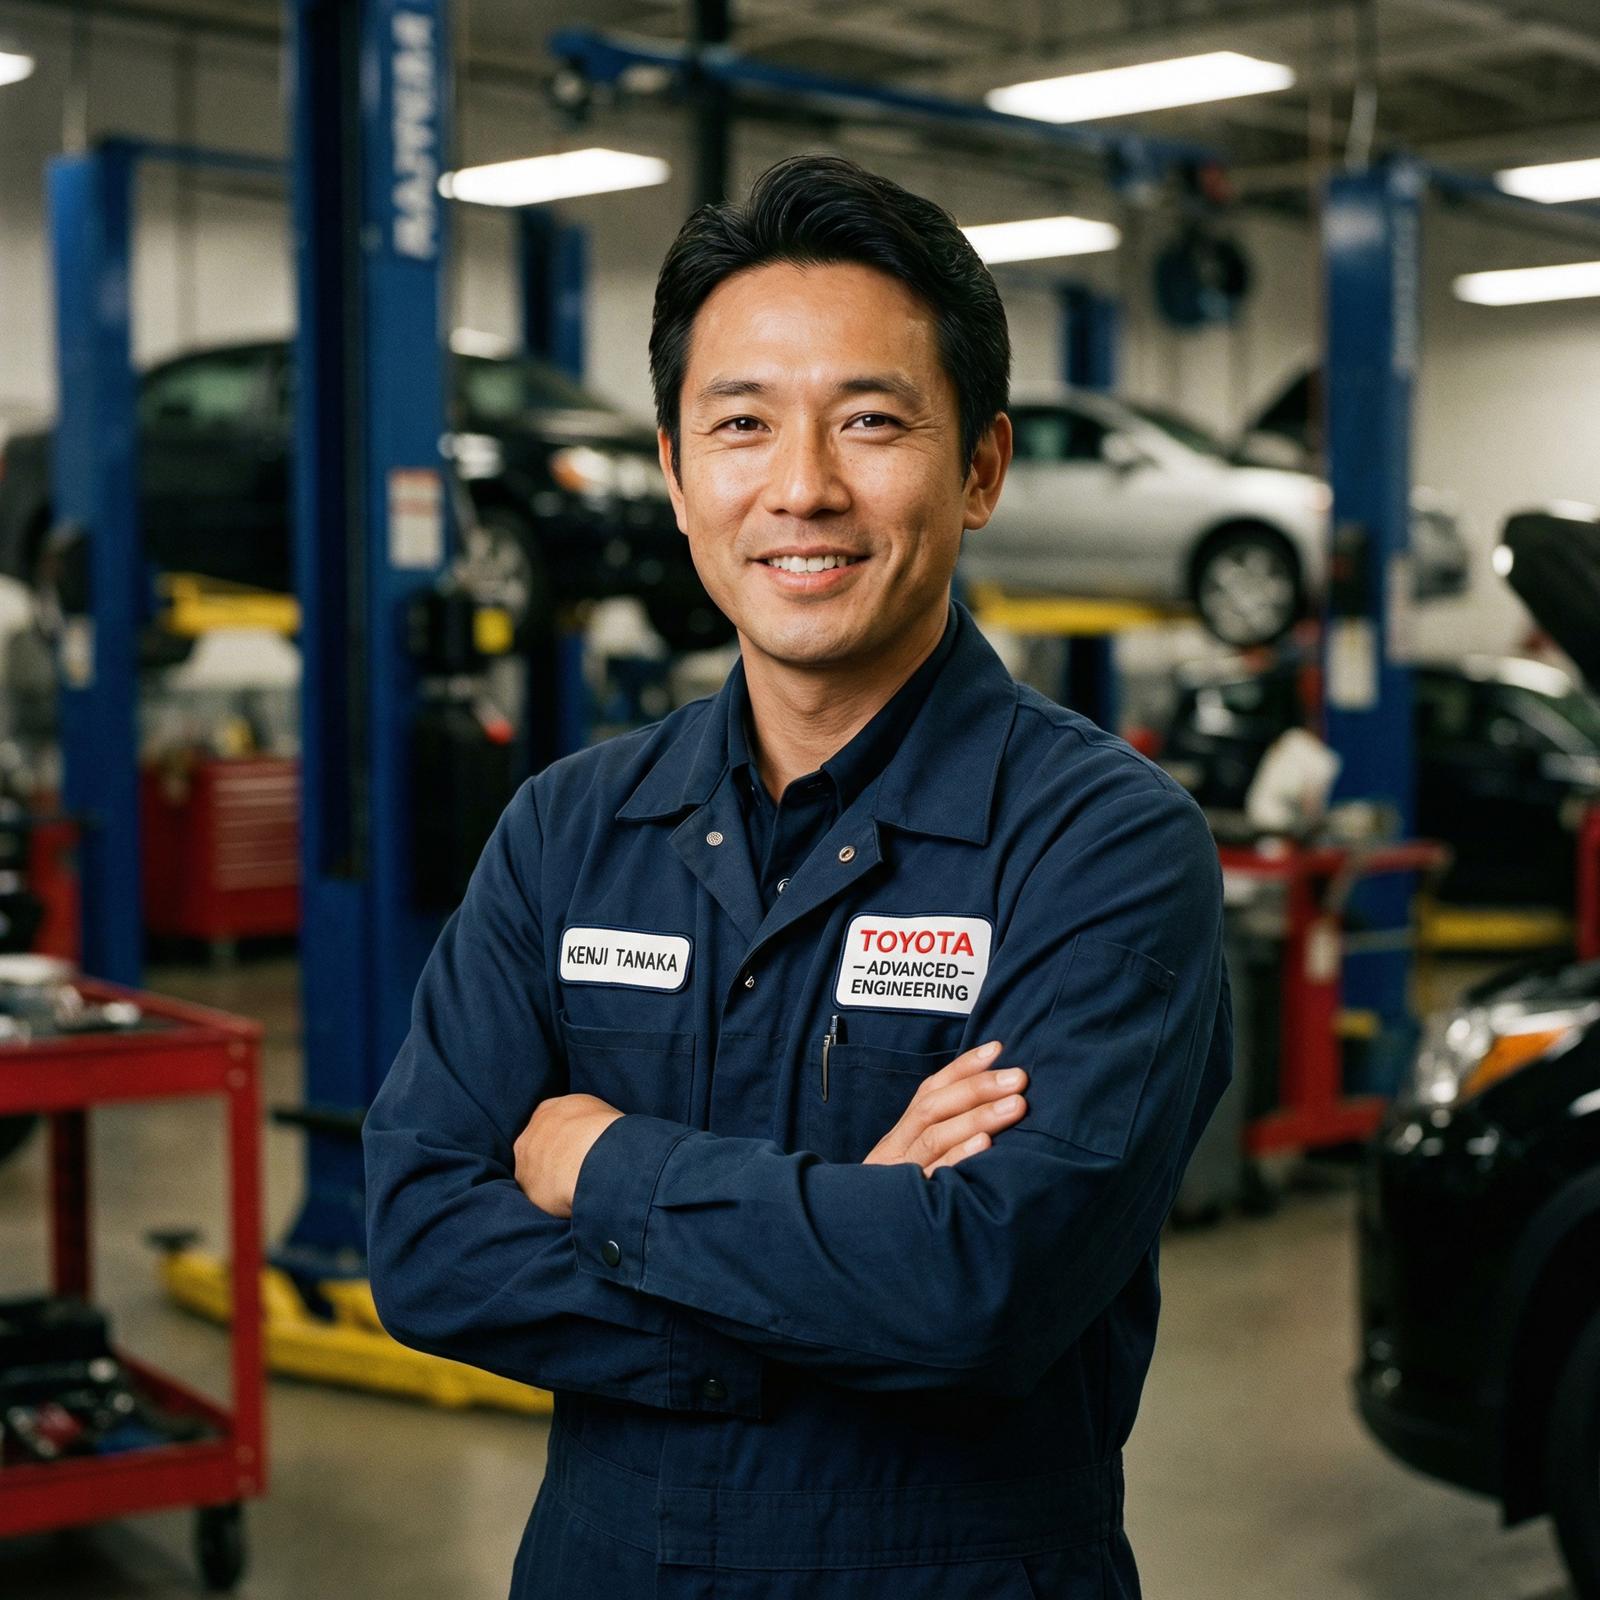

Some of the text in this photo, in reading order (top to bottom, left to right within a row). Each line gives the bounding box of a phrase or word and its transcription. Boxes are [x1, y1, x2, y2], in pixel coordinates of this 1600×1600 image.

[860, 929, 975, 956] TOYOTA
[567, 945, 678, 972] KENJI TANAKA
[851, 979, 969, 1001] ENGINEERING
